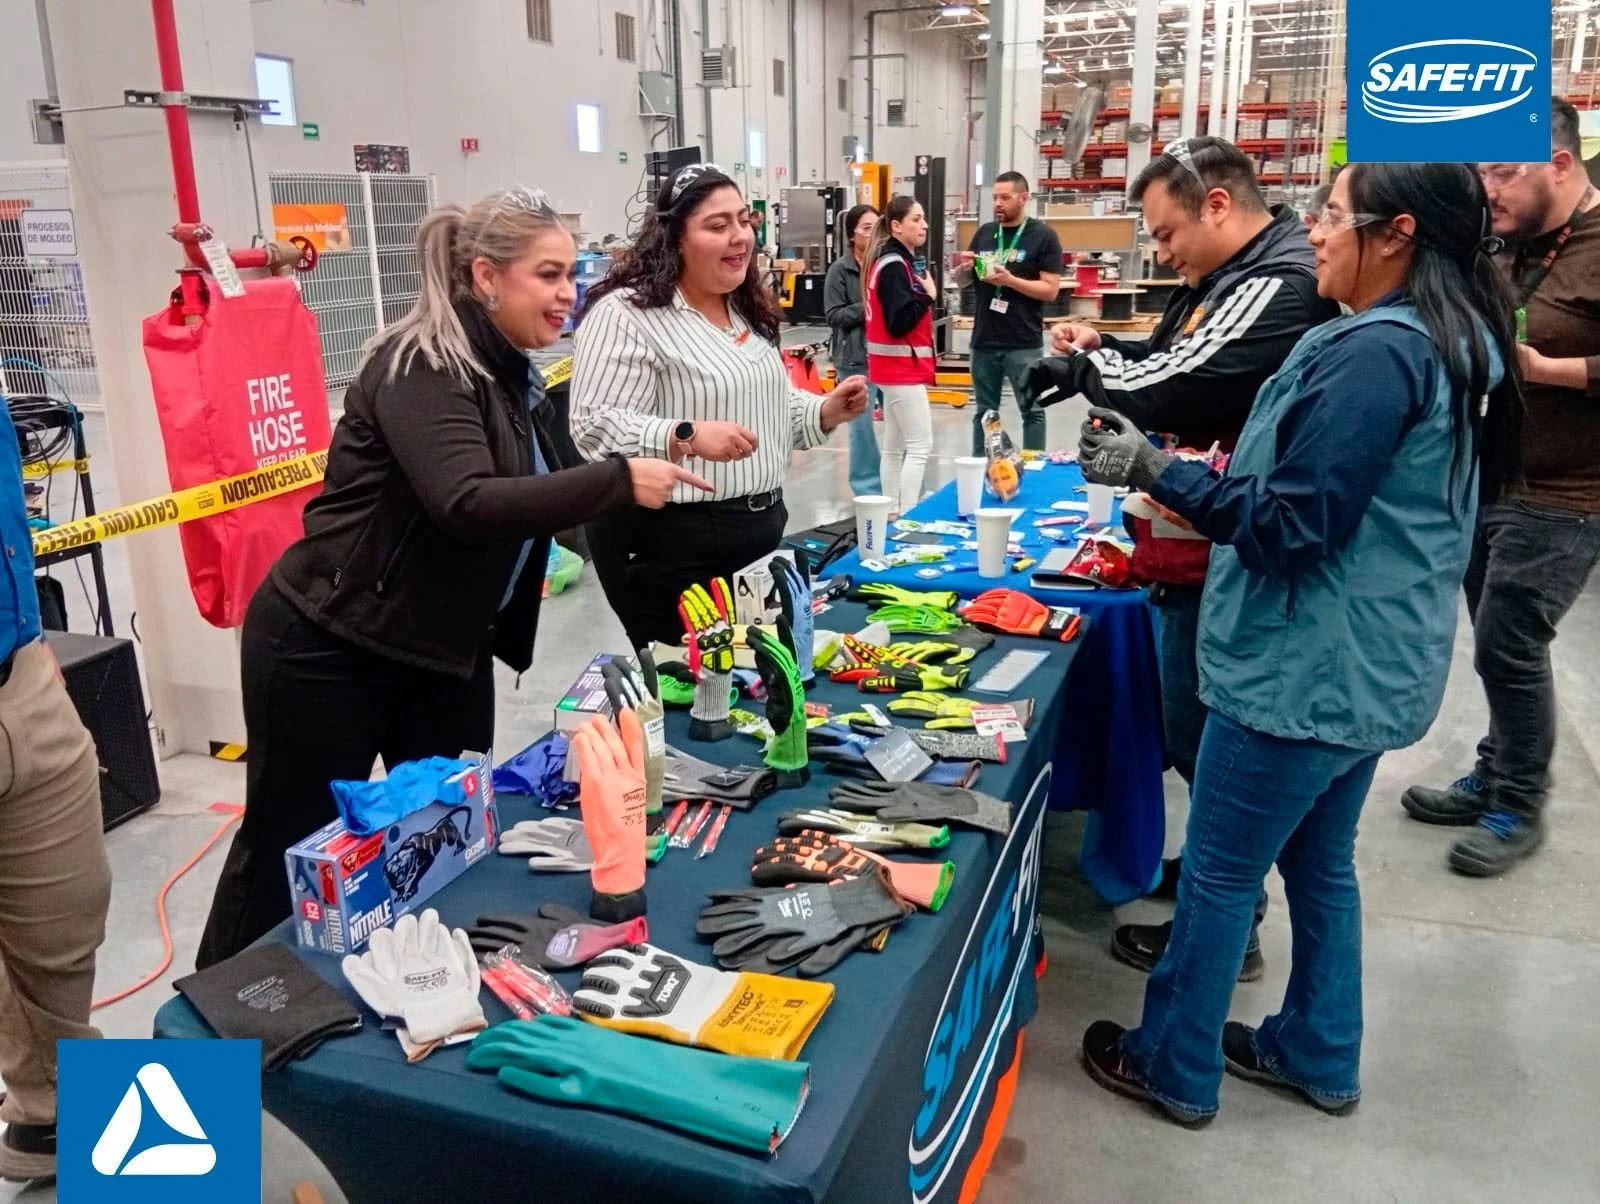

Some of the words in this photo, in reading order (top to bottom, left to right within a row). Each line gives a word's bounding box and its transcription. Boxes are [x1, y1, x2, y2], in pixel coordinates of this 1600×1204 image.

[27, 221, 71, 232] PROCESOS
[27, 233, 39, 243] DE
[40, 233, 73, 243] MOLDEO
[247, 373, 295, 416] FIRE
[249, 410, 307, 457] HOSE
[103, 498, 180, 538] CAUTION
[305, 901, 321, 921] CH
[327, 908, 345, 953] NITRILO
[348, 898, 393, 947] NITRILE
